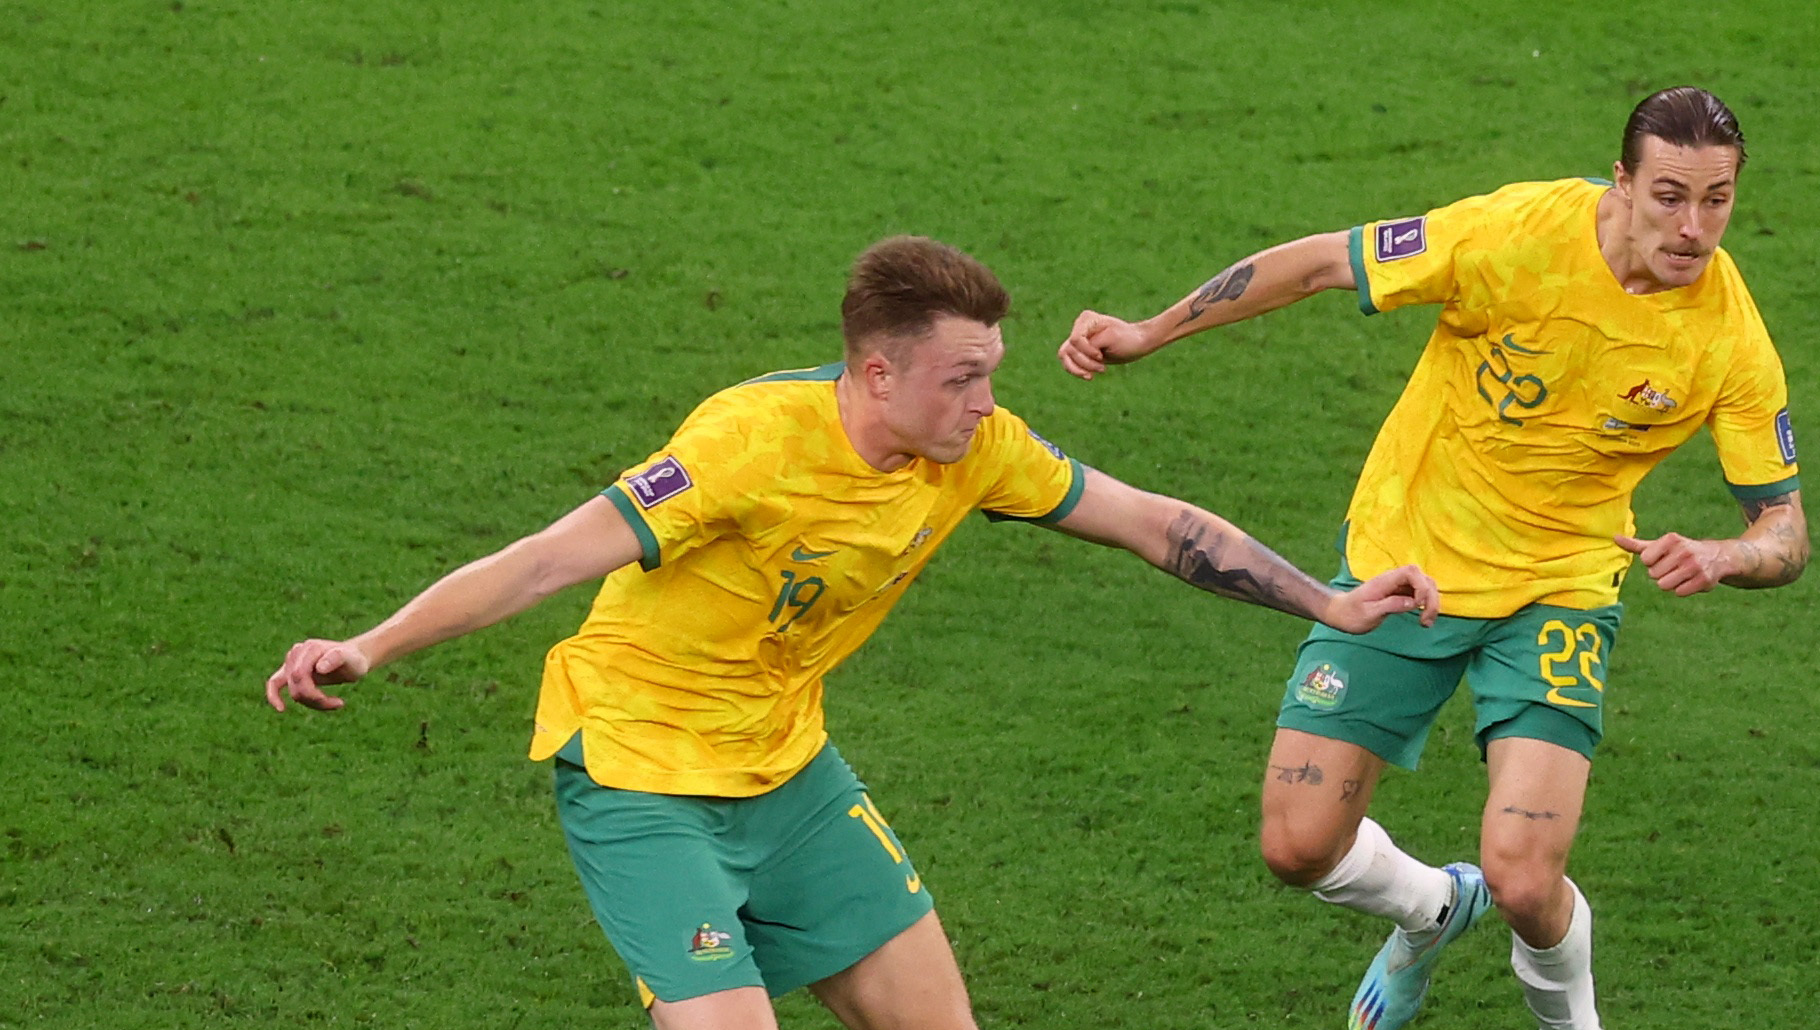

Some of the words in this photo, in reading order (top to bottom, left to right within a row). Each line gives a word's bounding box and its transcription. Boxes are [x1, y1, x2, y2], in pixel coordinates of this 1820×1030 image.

[1476, 347, 1548, 427] 22
[768, 569, 825, 633] 19
[1537, 619, 1604, 692] 22
